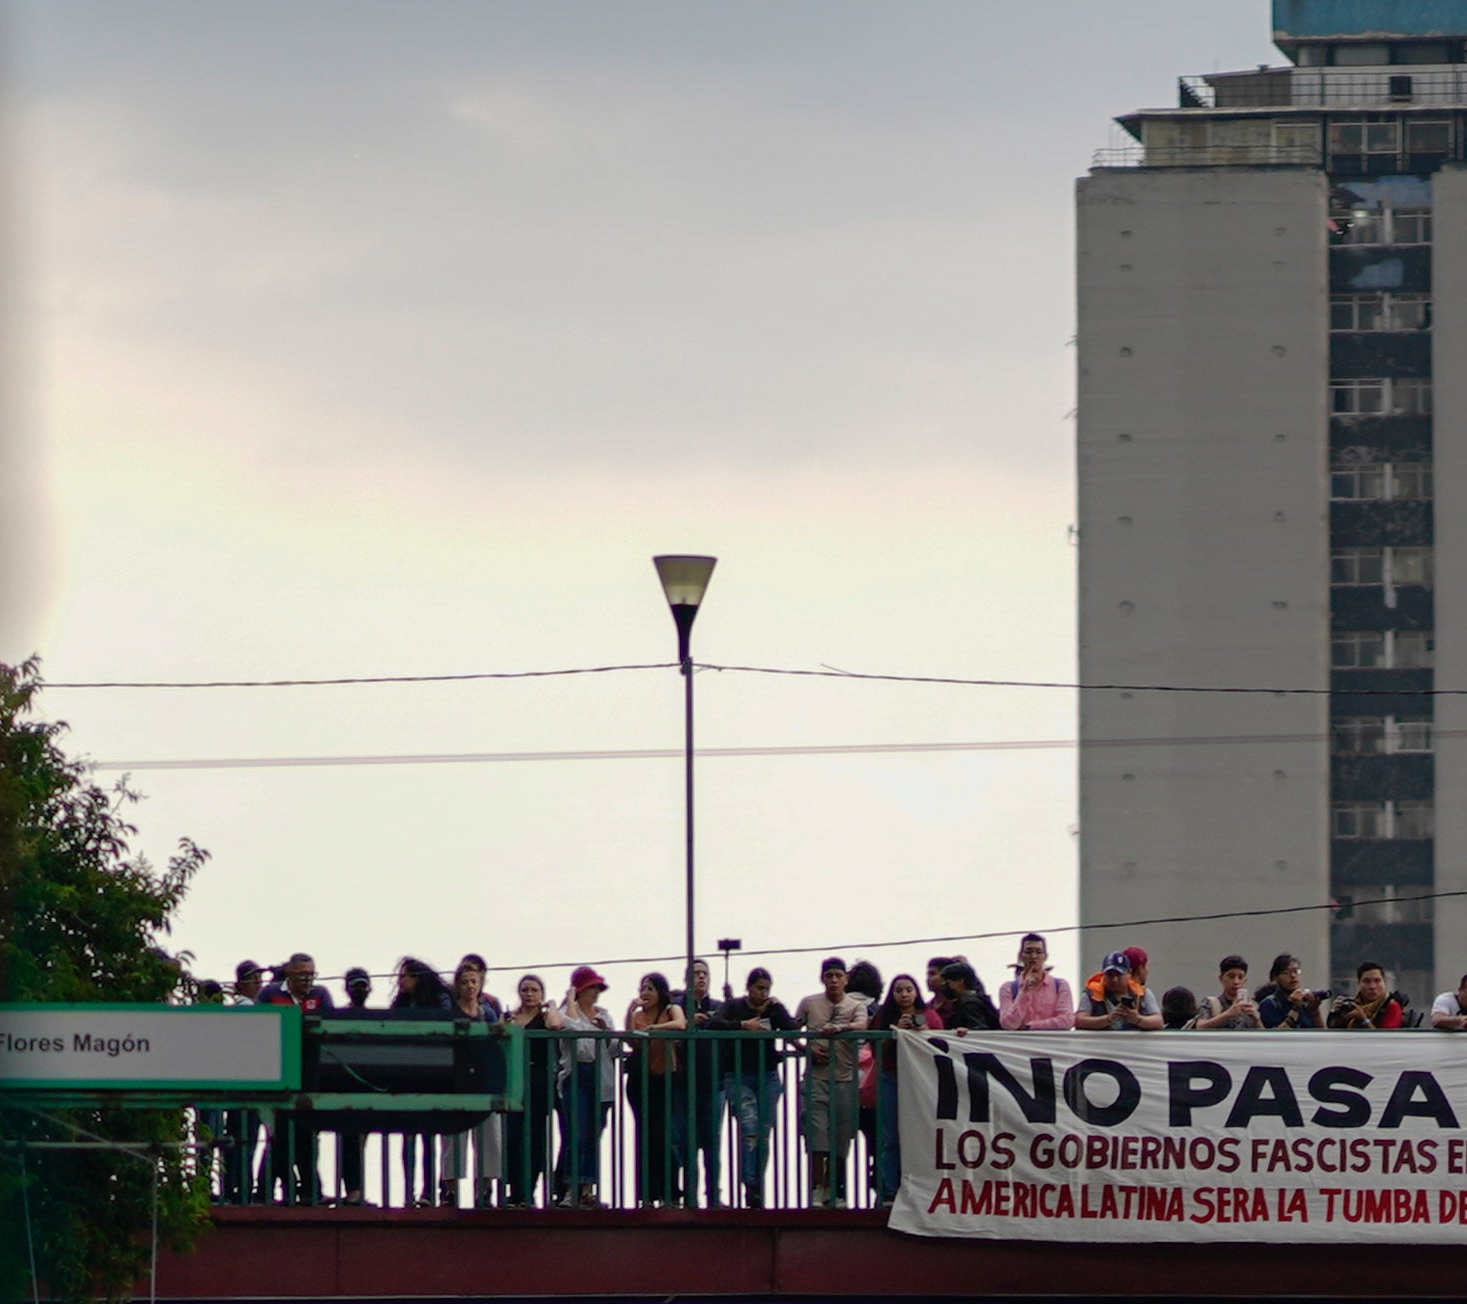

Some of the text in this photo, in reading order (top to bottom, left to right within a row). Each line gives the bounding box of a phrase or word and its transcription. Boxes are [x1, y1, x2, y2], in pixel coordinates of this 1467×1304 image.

[73, 1032, 150, 1058] Magón
[935, 1127, 1016, 1171] LOS
[1029, 1133, 1241, 1173] GOBIERNOS
[1250, 1138, 1438, 1175] FASCISTAS
[927, 1177, 1074, 1219] AMERICA
[1080, 1183, 1185, 1223] LATINA
[1189, 1185, 1270, 1225] SERA
[1277, 1187, 1309, 1223] LA
[1319, 1188, 1431, 1225] TUMBA
